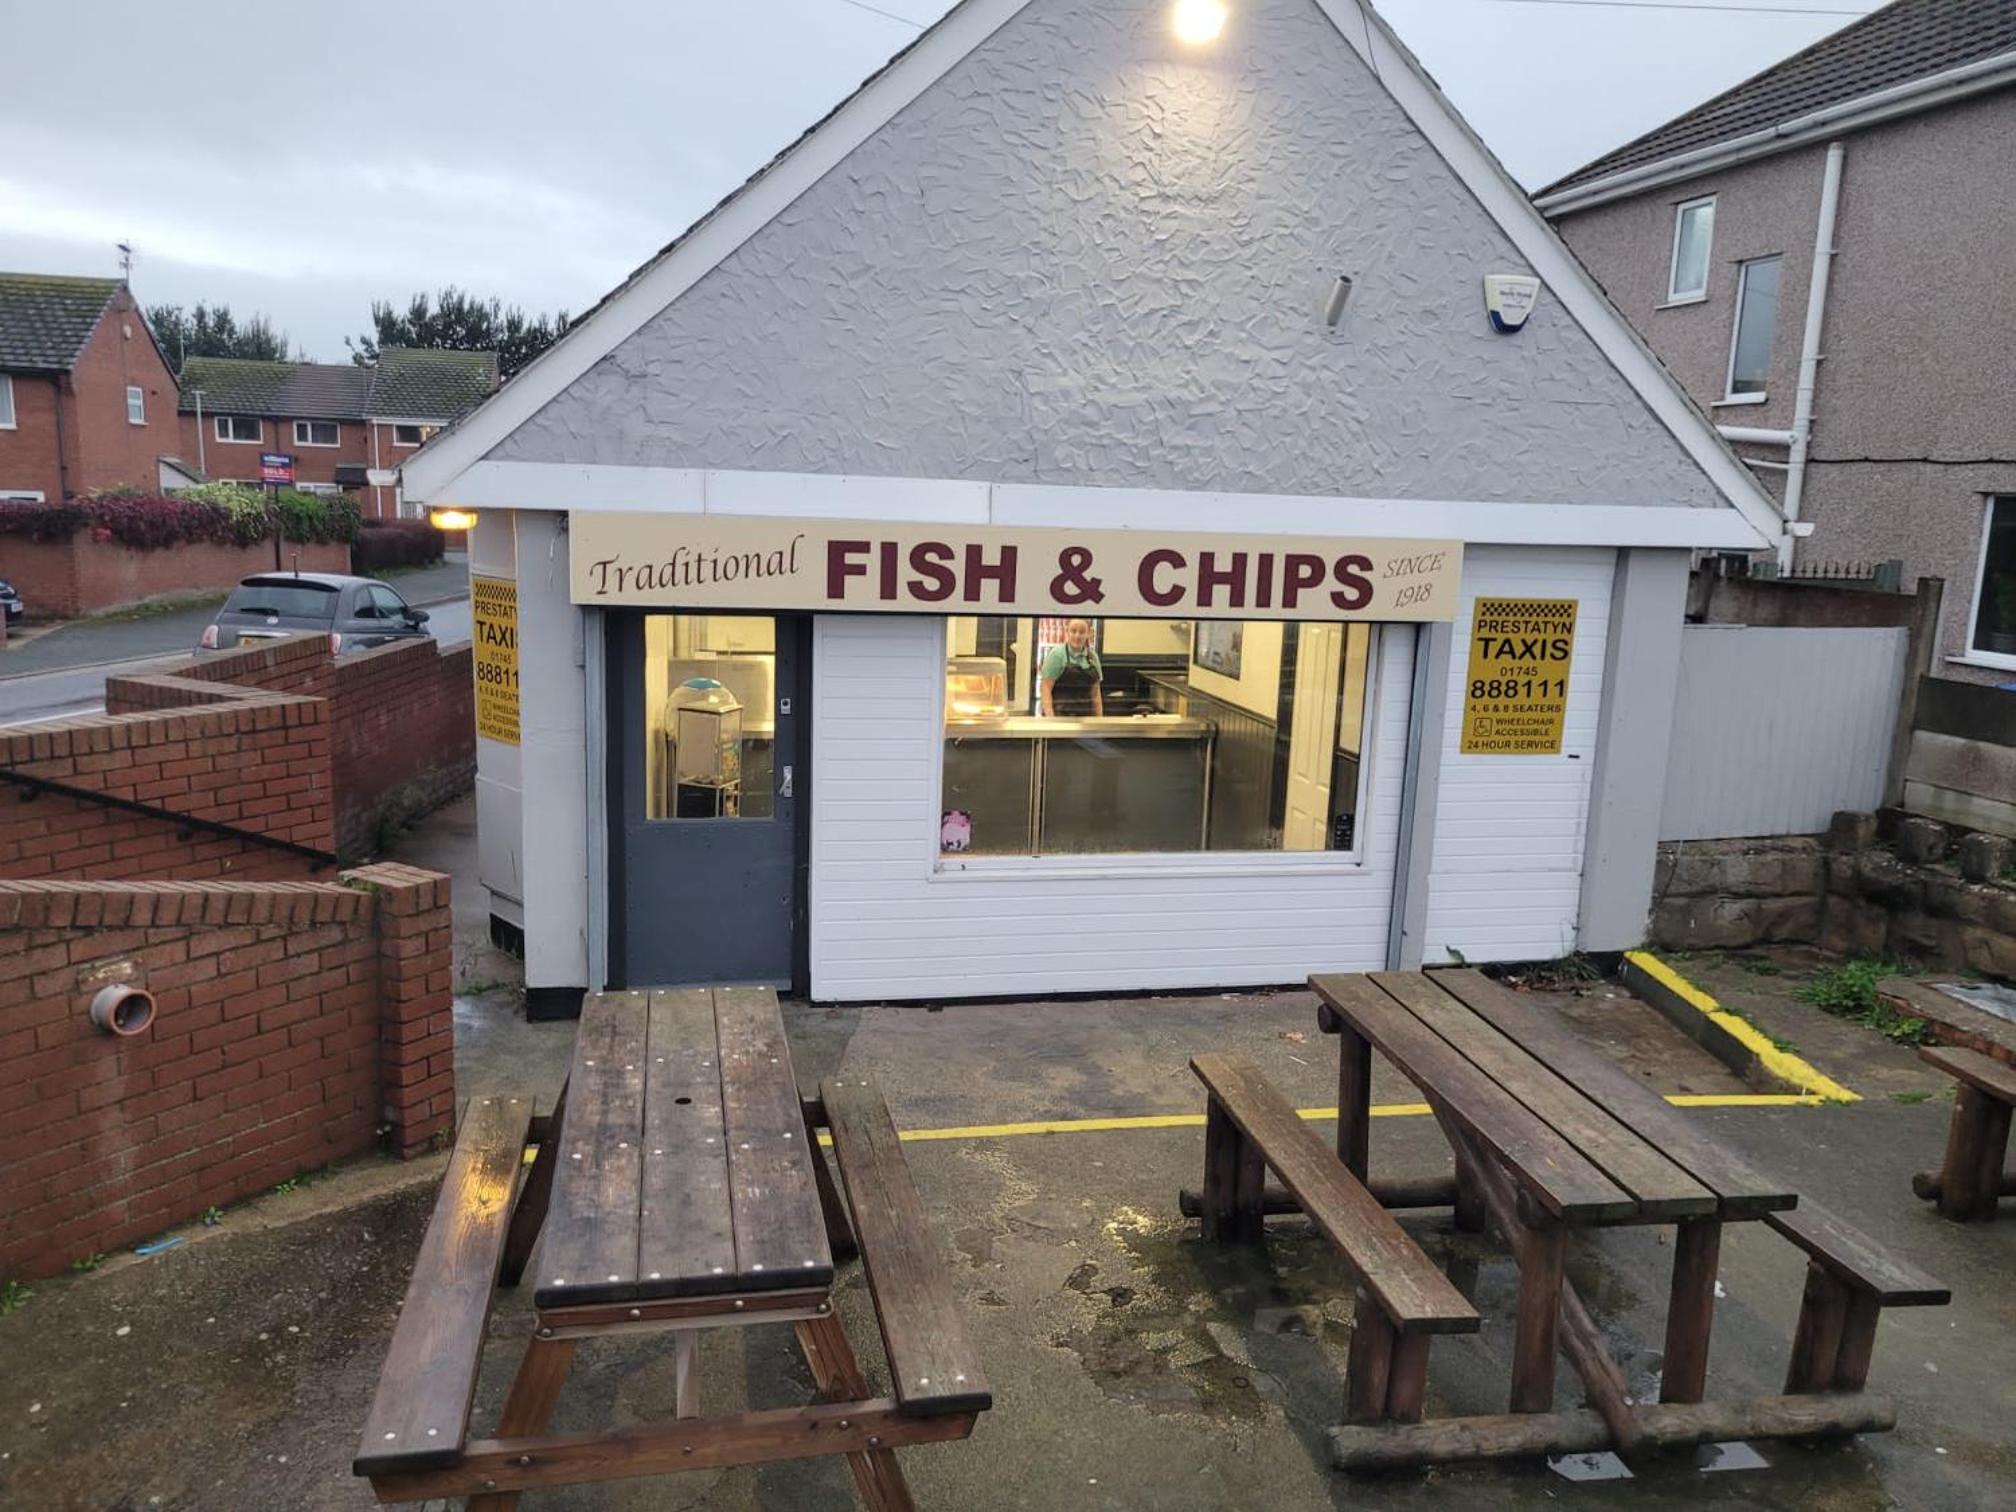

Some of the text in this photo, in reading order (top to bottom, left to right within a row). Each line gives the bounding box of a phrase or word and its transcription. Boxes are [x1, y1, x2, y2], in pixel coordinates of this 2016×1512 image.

[589, 534, 1375, 611] Traditional FISH & CHIPS
[1383, 552, 1446, 578] SINCE
[1394, 582, 1433, 608] 1918
[476, 620, 518, 649] TAXI
[1477, 619, 1572, 635] PRESTATYN
[1476, 637, 1569, 661] TAXIS
[1500, 666, 1538, 677] 01745
[1471, 679, 1565, 699] 888111
[1512, 704, 1561, 713] SEATERS
[1495, 717, 1554, 726] WHEELCHAIR
[1494, 728, 1550, 737] ACCESSIBLE
[1467, 740, 1557, 750] 24 HOUR SERVICE
